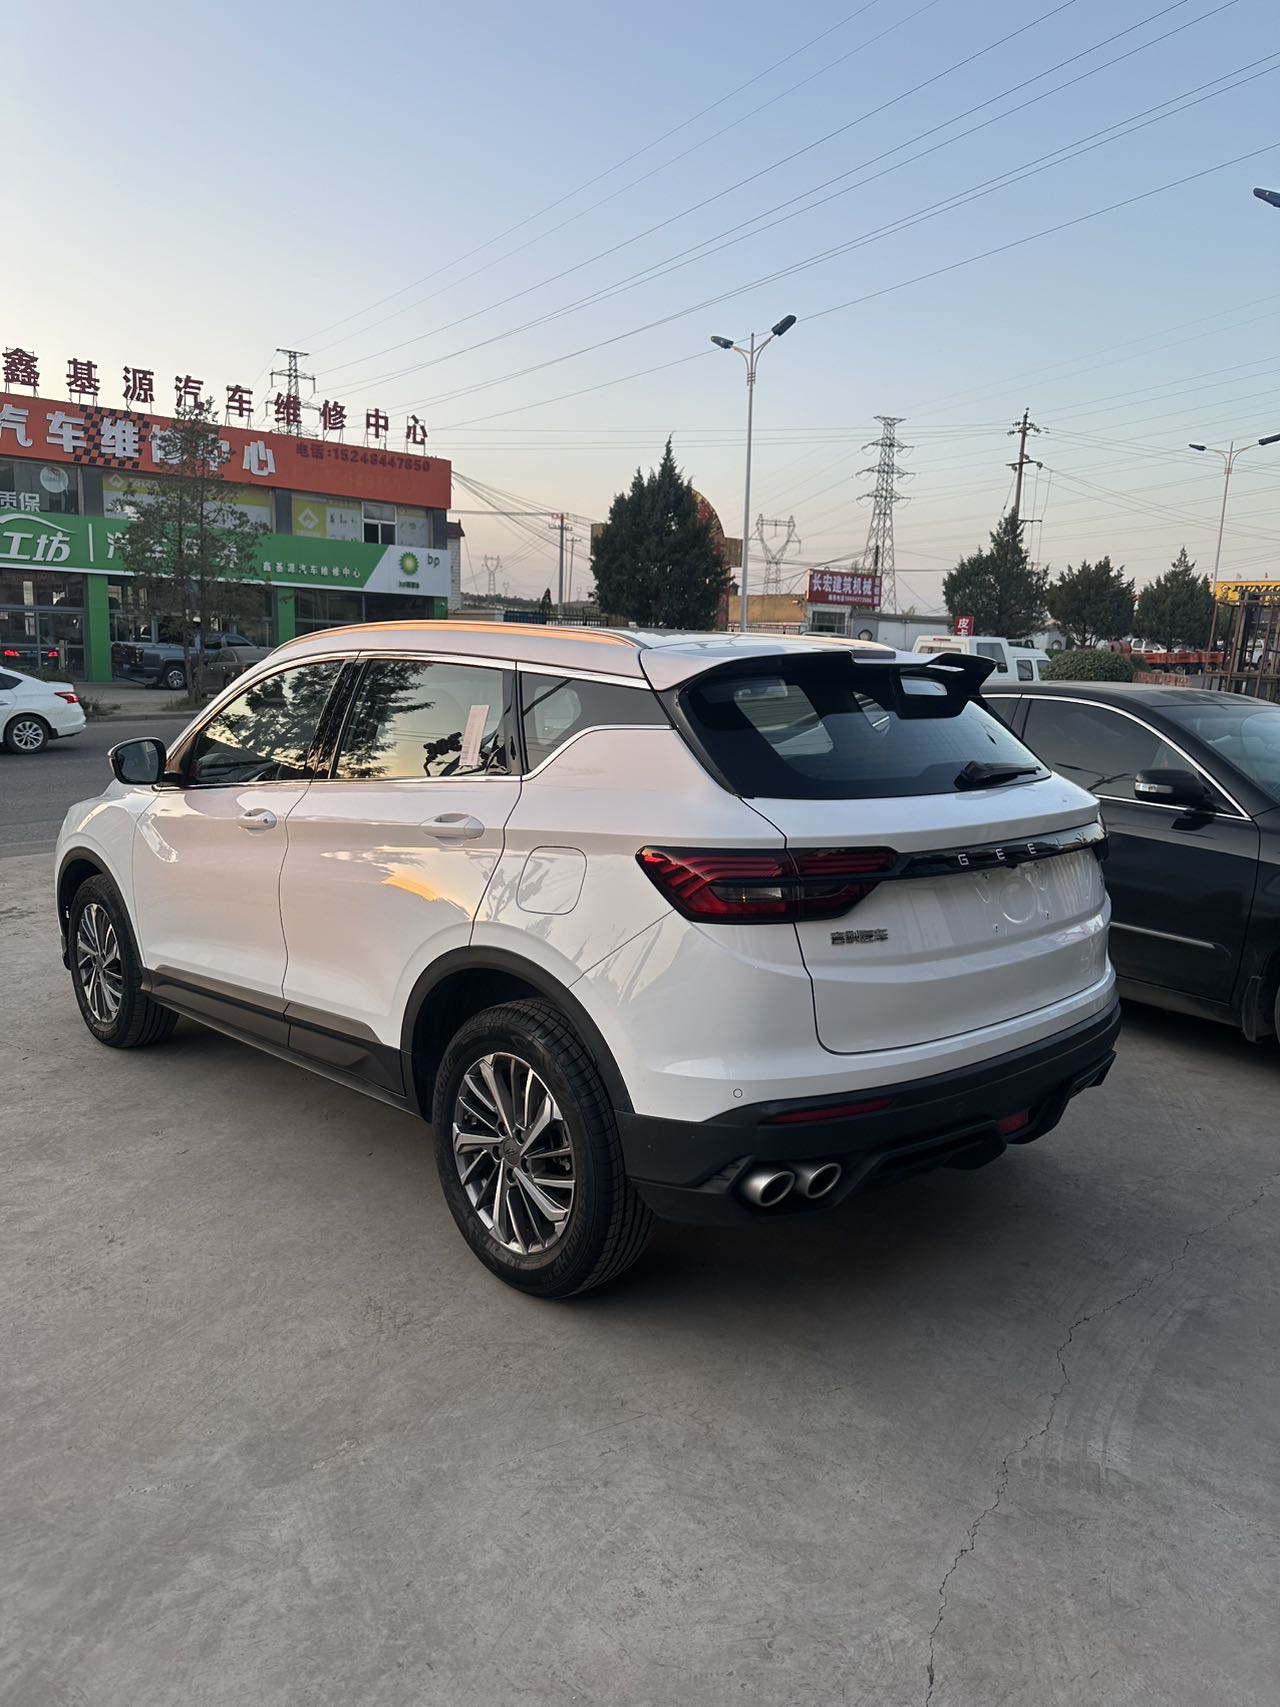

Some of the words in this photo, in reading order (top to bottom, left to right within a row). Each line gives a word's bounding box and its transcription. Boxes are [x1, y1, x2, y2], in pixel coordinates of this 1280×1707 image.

[2, 348, 428, 445] 鑫基源汽车维修中心
[0, 531, 71, 562] 工坊
[427, 553, 440, 568] bp
[811, 573, 873, 596] 长宏建筑机械
[958, 832, 1087, 866] GEELY
